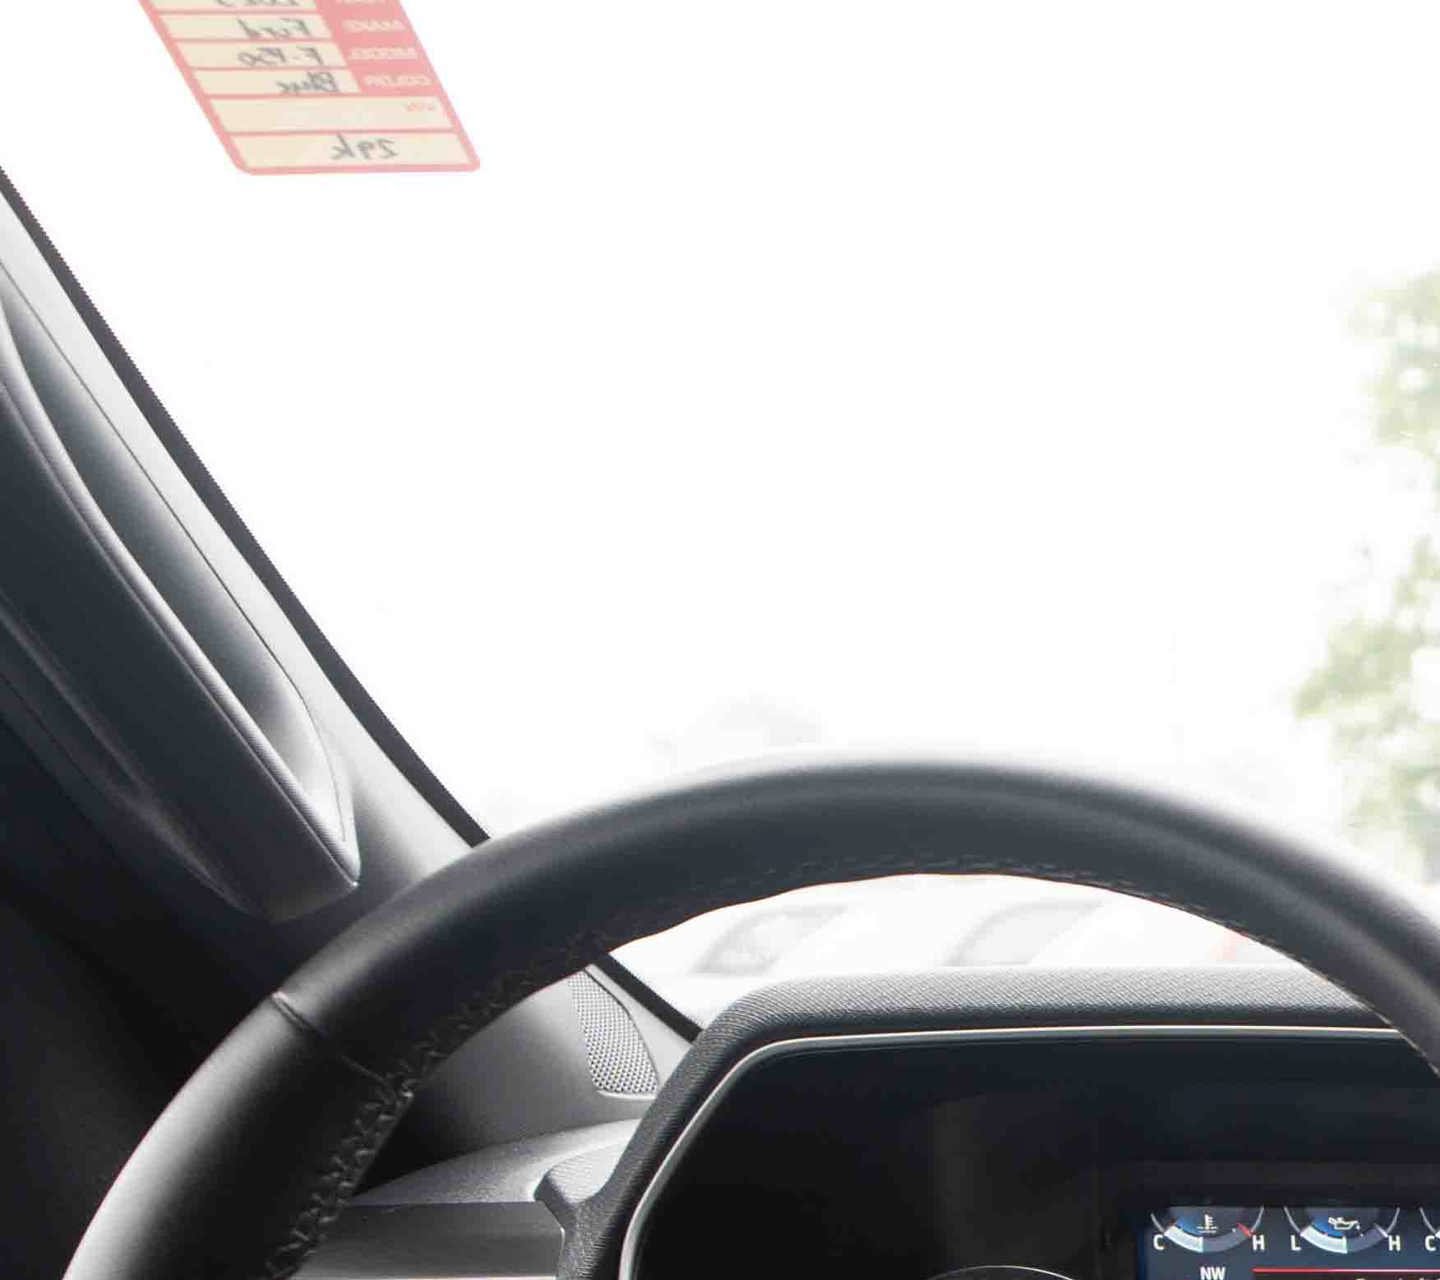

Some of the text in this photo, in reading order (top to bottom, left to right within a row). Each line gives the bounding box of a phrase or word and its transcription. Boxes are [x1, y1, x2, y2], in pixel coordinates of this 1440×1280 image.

[1153, 1231, 1167, 1251] C
[1252, 1234, 1265, 1251] H
[1290, 1231, 1303, 1252] L
[1386, 1233, 1401, 1252] H
[1424, 1232, 1438, 1252] C
